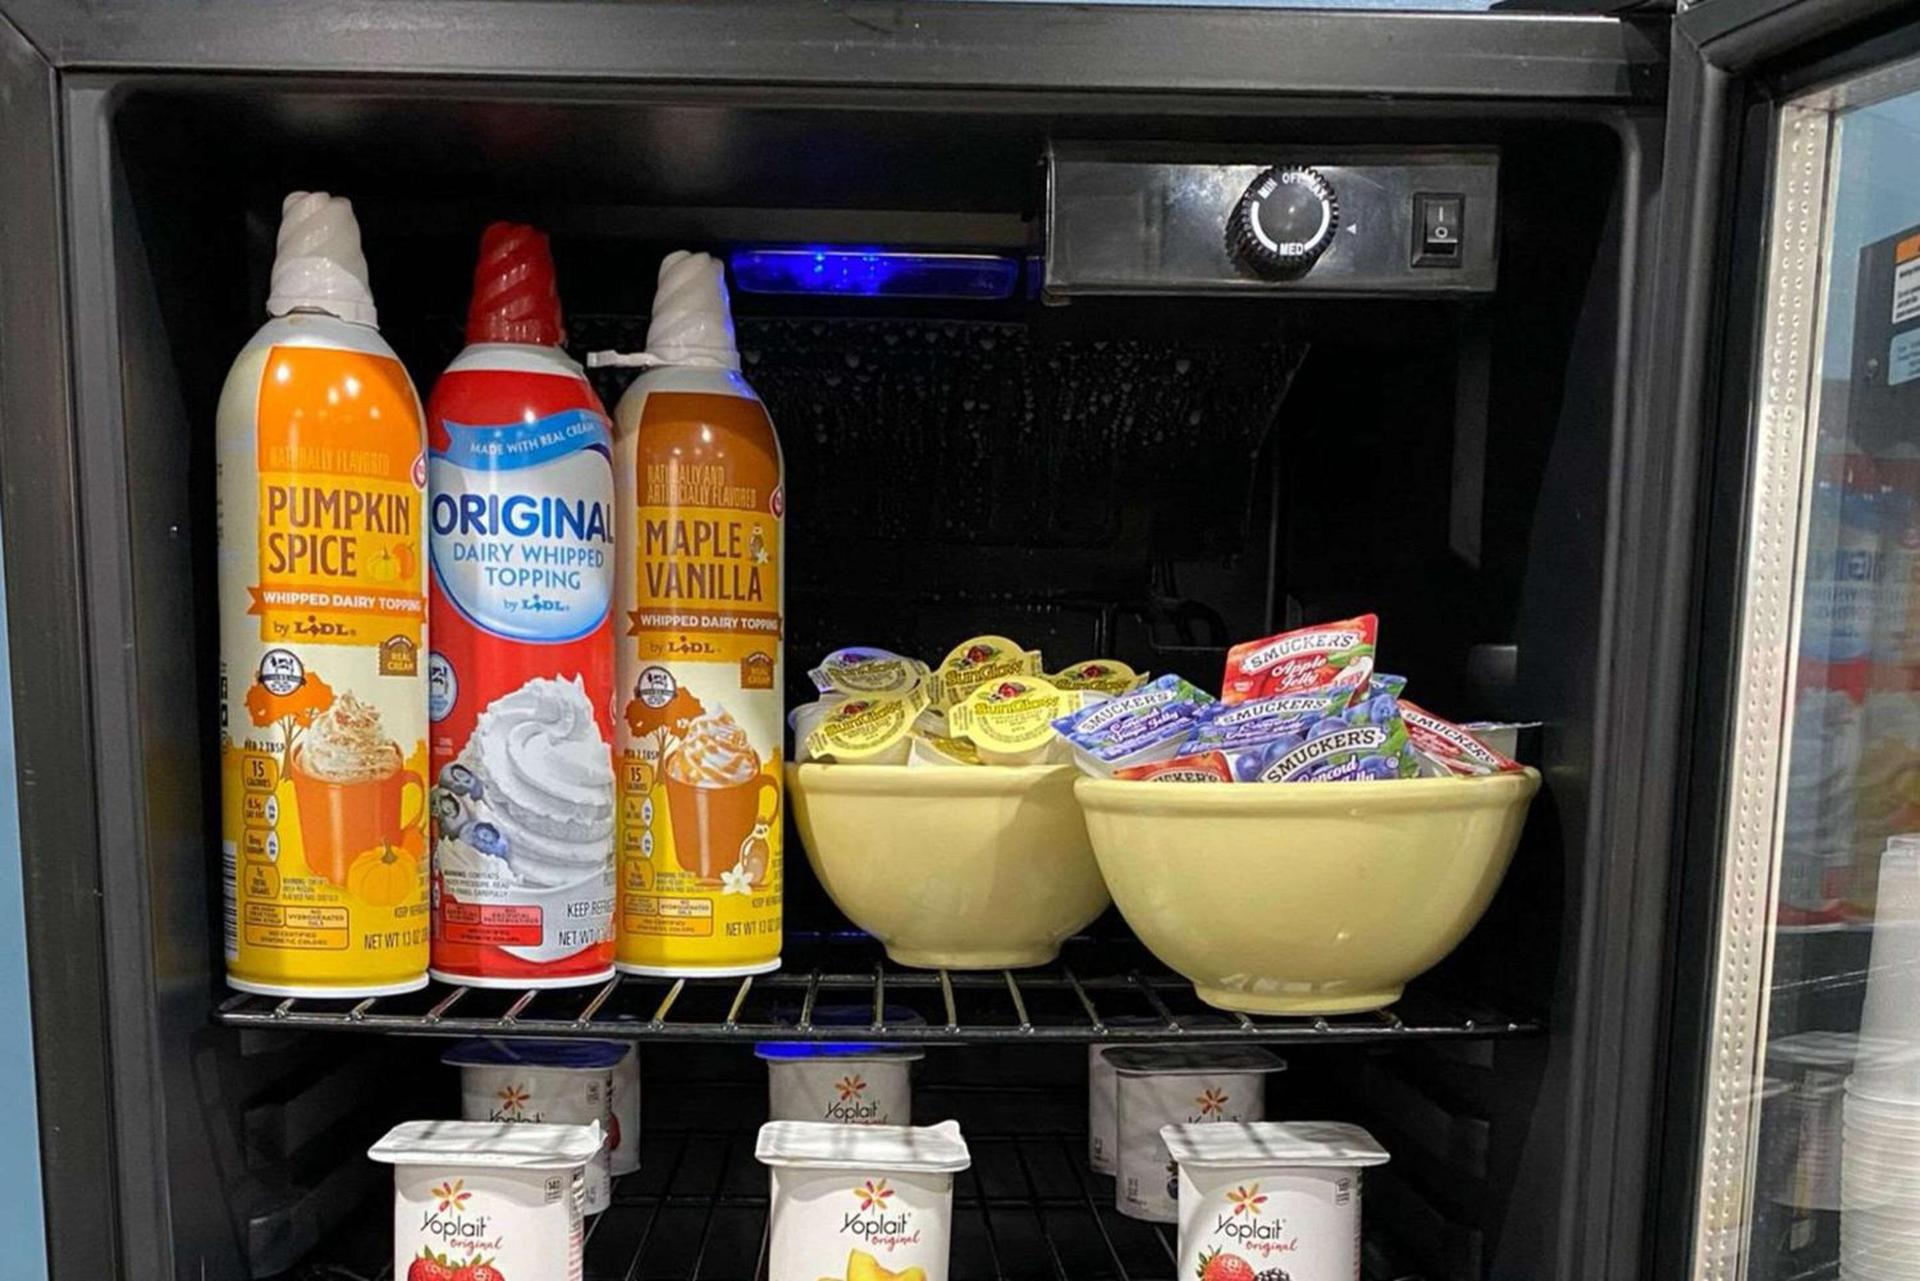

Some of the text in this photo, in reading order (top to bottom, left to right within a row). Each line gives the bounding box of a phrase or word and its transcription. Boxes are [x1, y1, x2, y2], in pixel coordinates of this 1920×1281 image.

[1257, 178, 1278, 199] MIN
[1279, 242, 1304, 255] MED
[470, 421, 595, 456] MADE WITH REAL CREAM
[647, 463, 701, 486] NATUALLY
[647, 483, 710, 505] ARTIICIALLY
[268, 486, 410, 535] PUMPKIN
[431, 493, 614, 545] ORIGINAL
[646, 519, 742, 559] MAPLE
[268, 532, 357, 578] SPICE
[453, 542, 604, 569] DAIRY WHIPPED
[485, 566, 581, 590] TOPPING
[646, 562, 763, 602] VANILLA
[263, 591, 422, 612] WHIPPED DAIRY TOPPING
[504, 598, 518, 613] by
[273, 621, 290, 636] by
[640, 614, 700, 627] WHIPPED
[701, 616, 739, 629] DAIRY
[1249, 634, 1353, 668] SMUCKER'S
[945, 658, 1024, 687] SunGlow
[1272, 654, 1327, 679] Apple
[1275, 672, 1319, 693] Jelly
[974, 695, 1060, 716] SunGlow
[1266, 729, 1376, 781] SMUCKER'S
[252, 760, 265, 777] 15
[630, 767, 642, 781] 15
[567, 902, 590, 918] KEEP
[365, 933, 382, 950] NET
[384, 932, 399, 948] WT
[559, 930, 576, 946] NET
[825, 1100, 877, 1123] Yoplait
[420, 1211, 488, 1242] Yoplait
[840, 1212, 908, 1242] Yoplait
[1215, 1214, 1283, 1244] Yoplait
[450, 1235, 503, 1256] original
[871, 1230, 921, 1252] original
[1246, 1238, 1299, 1258] original
